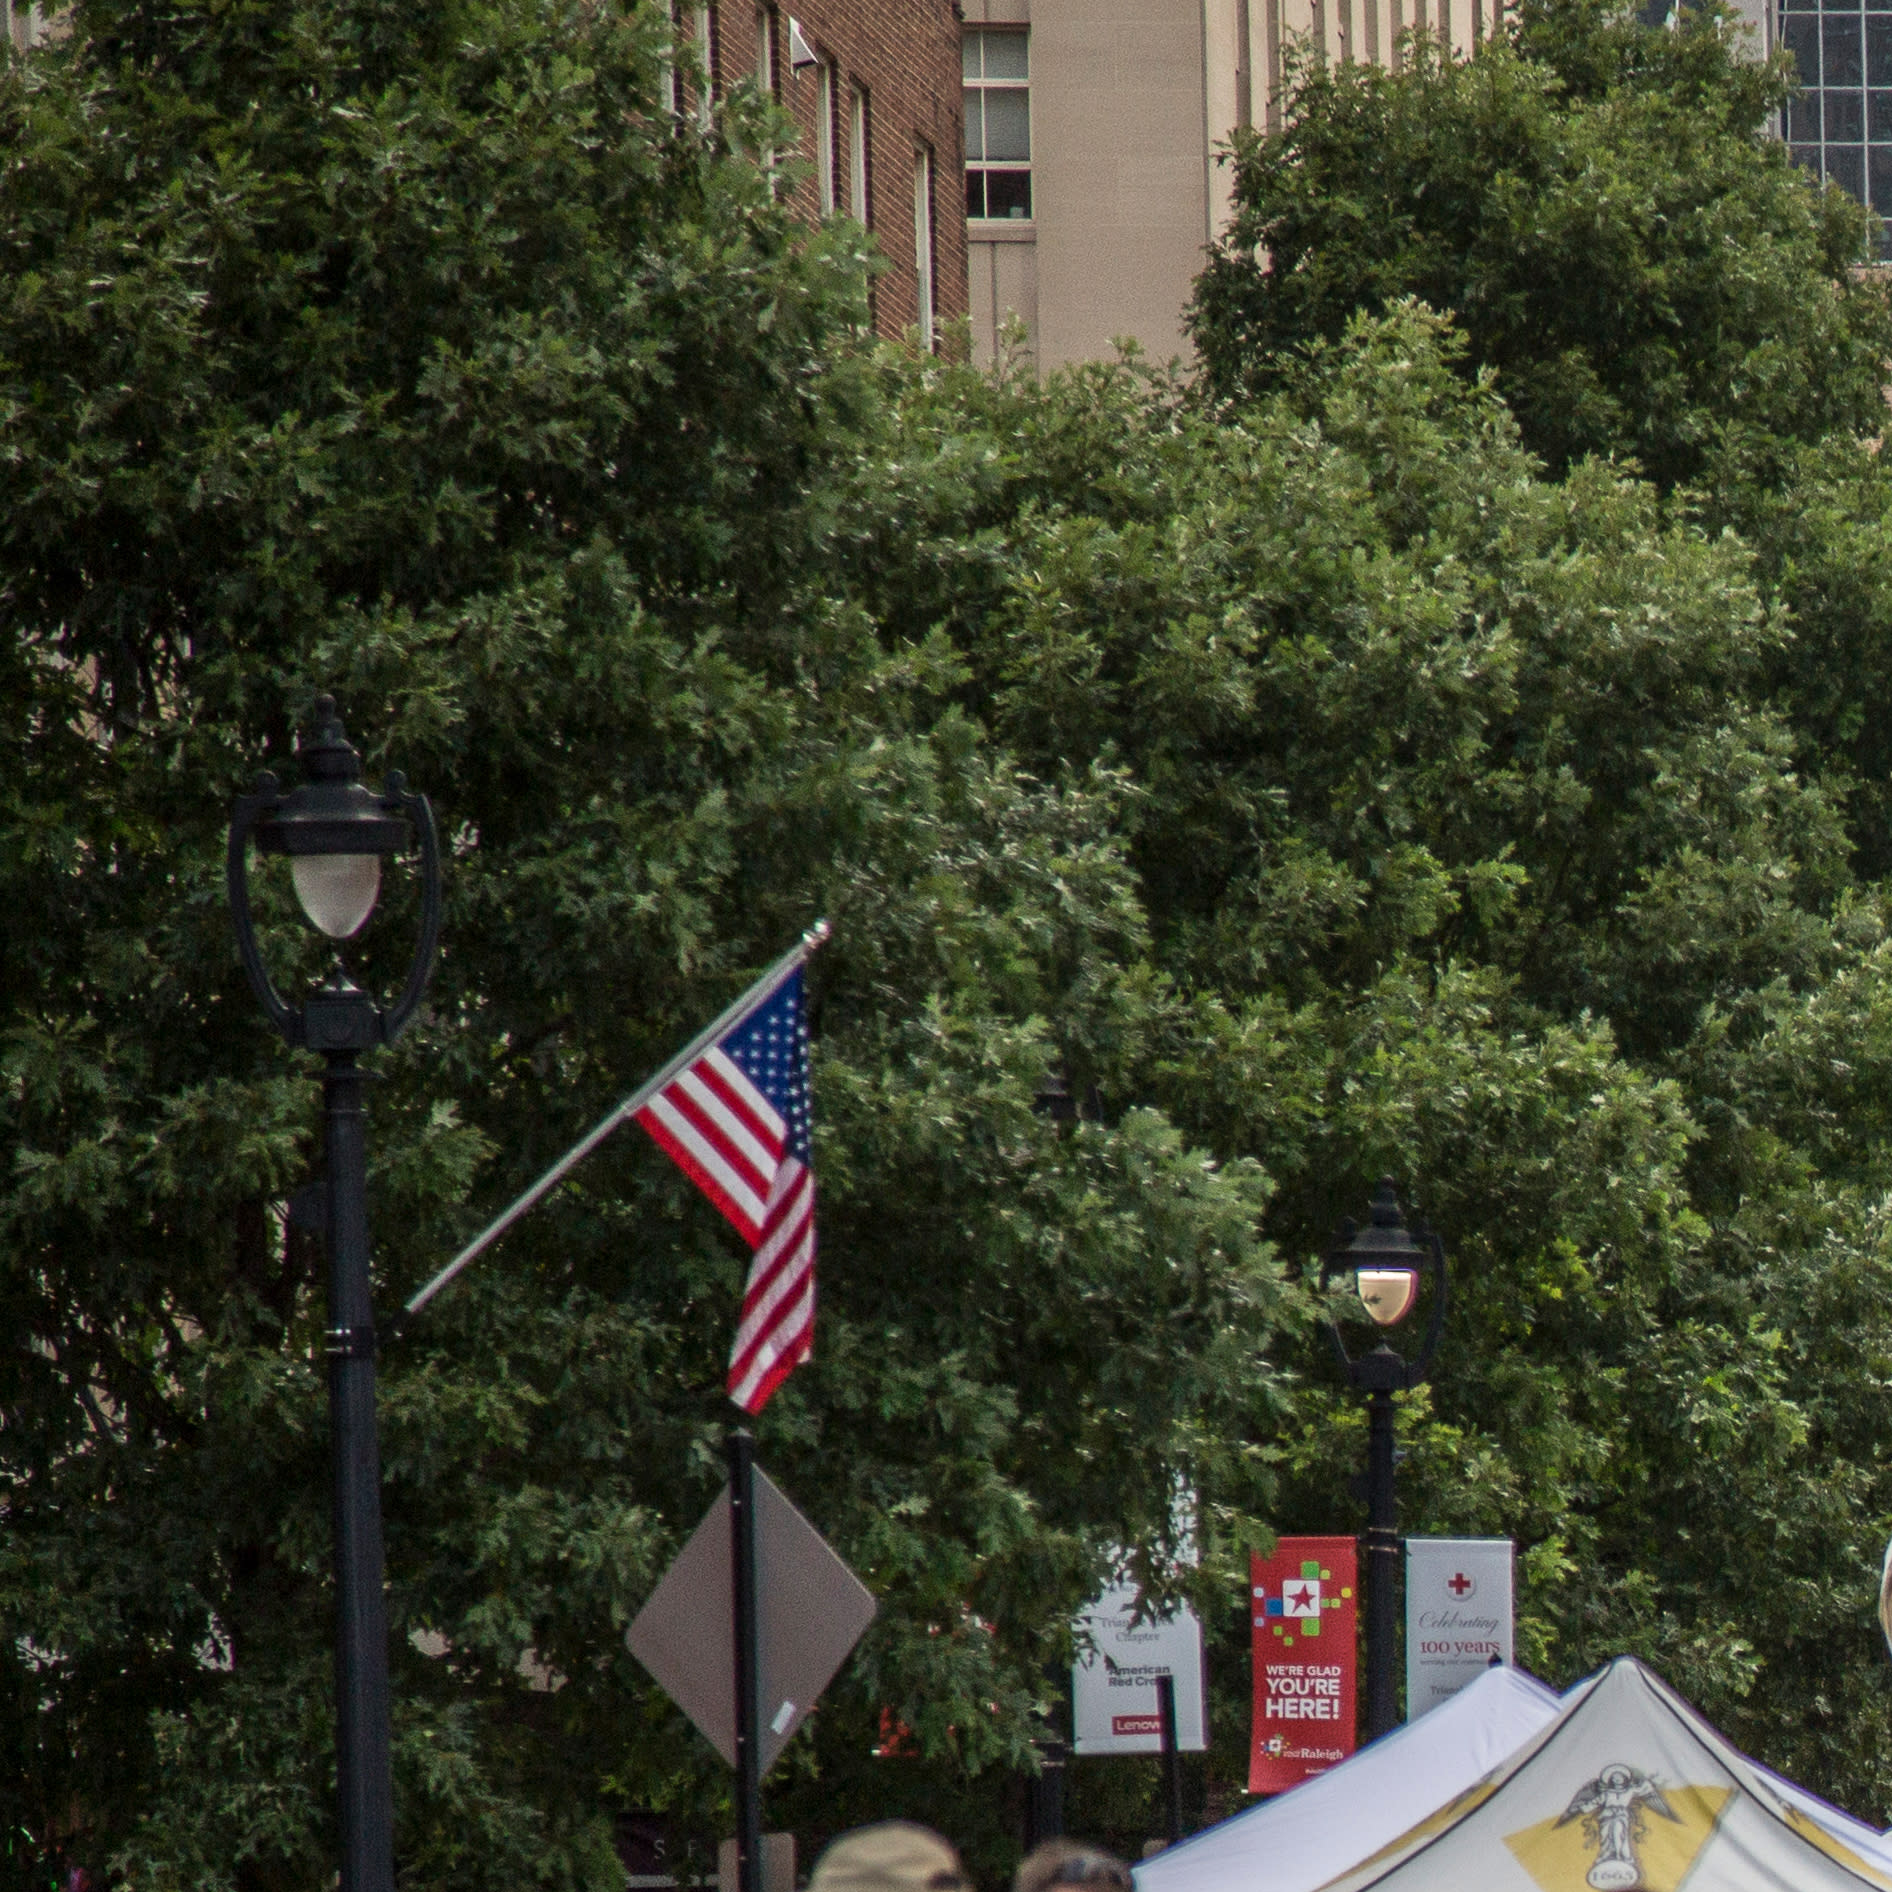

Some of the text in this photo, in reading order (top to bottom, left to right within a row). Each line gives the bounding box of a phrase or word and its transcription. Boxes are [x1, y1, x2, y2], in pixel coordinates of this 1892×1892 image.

[1418, 1610, 1500, 1638] Celebrating
[1115, 1631, 1160, 1644] Chapter
[1420, 1640, 1501, 1658] 100 years
[1109, 1664, 1171, 1675] American
[1265, 1664, 1341, 1677] WE'RE GLAD
[1108, 1676, 1158, 1687] Red Cro
[1265, 1677, 1341, 1696] YOU'RE
[1265, 1697, 1340, 1720] HERE!
[1116, 1718, 1161, 1732] Lenov
